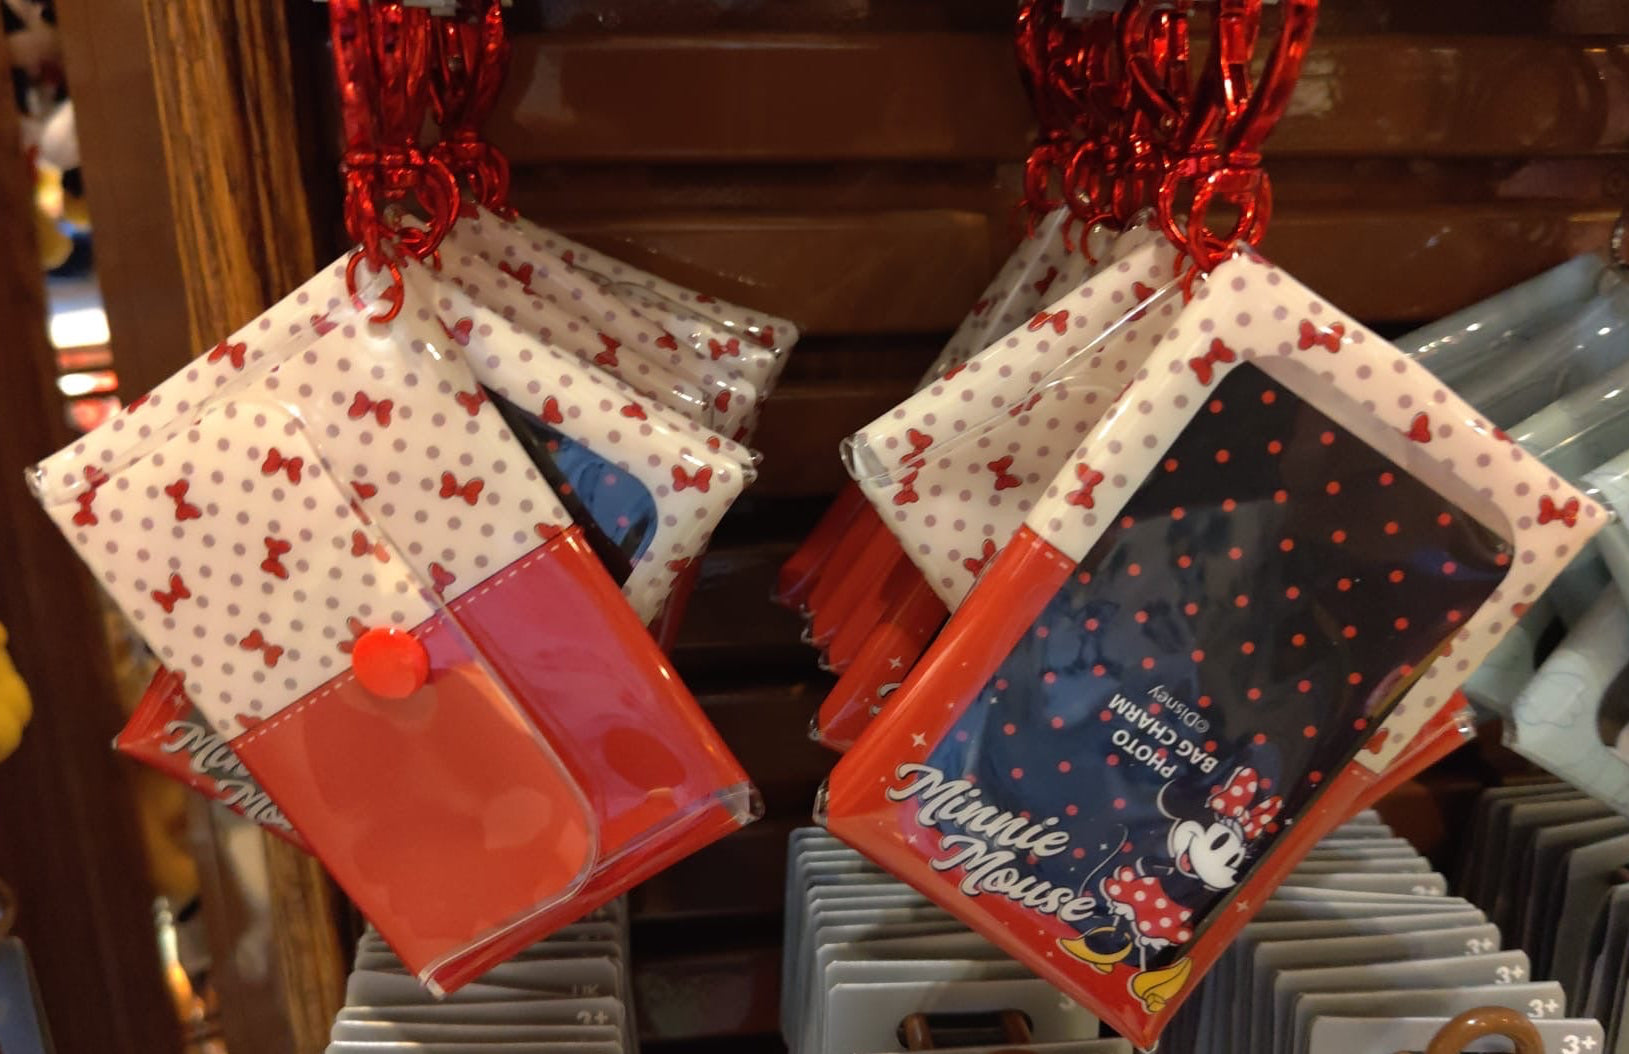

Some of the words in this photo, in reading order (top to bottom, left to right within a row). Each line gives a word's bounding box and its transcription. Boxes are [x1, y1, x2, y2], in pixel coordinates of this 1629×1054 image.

[1108, 693, 1178, 745] CHARM
[1112, 729, 1178, 778] PHOTO
[1175, 739, 1219, 773] BAG
[887, 763, 1069, 857] Minnie
[931, 835, 1096, 922] Mouse
[1495, 965, 1524, 984] 3+
[1527, 998, 1559, 1018] 3+
[1561, 1034, 1597, 1054] 3+
